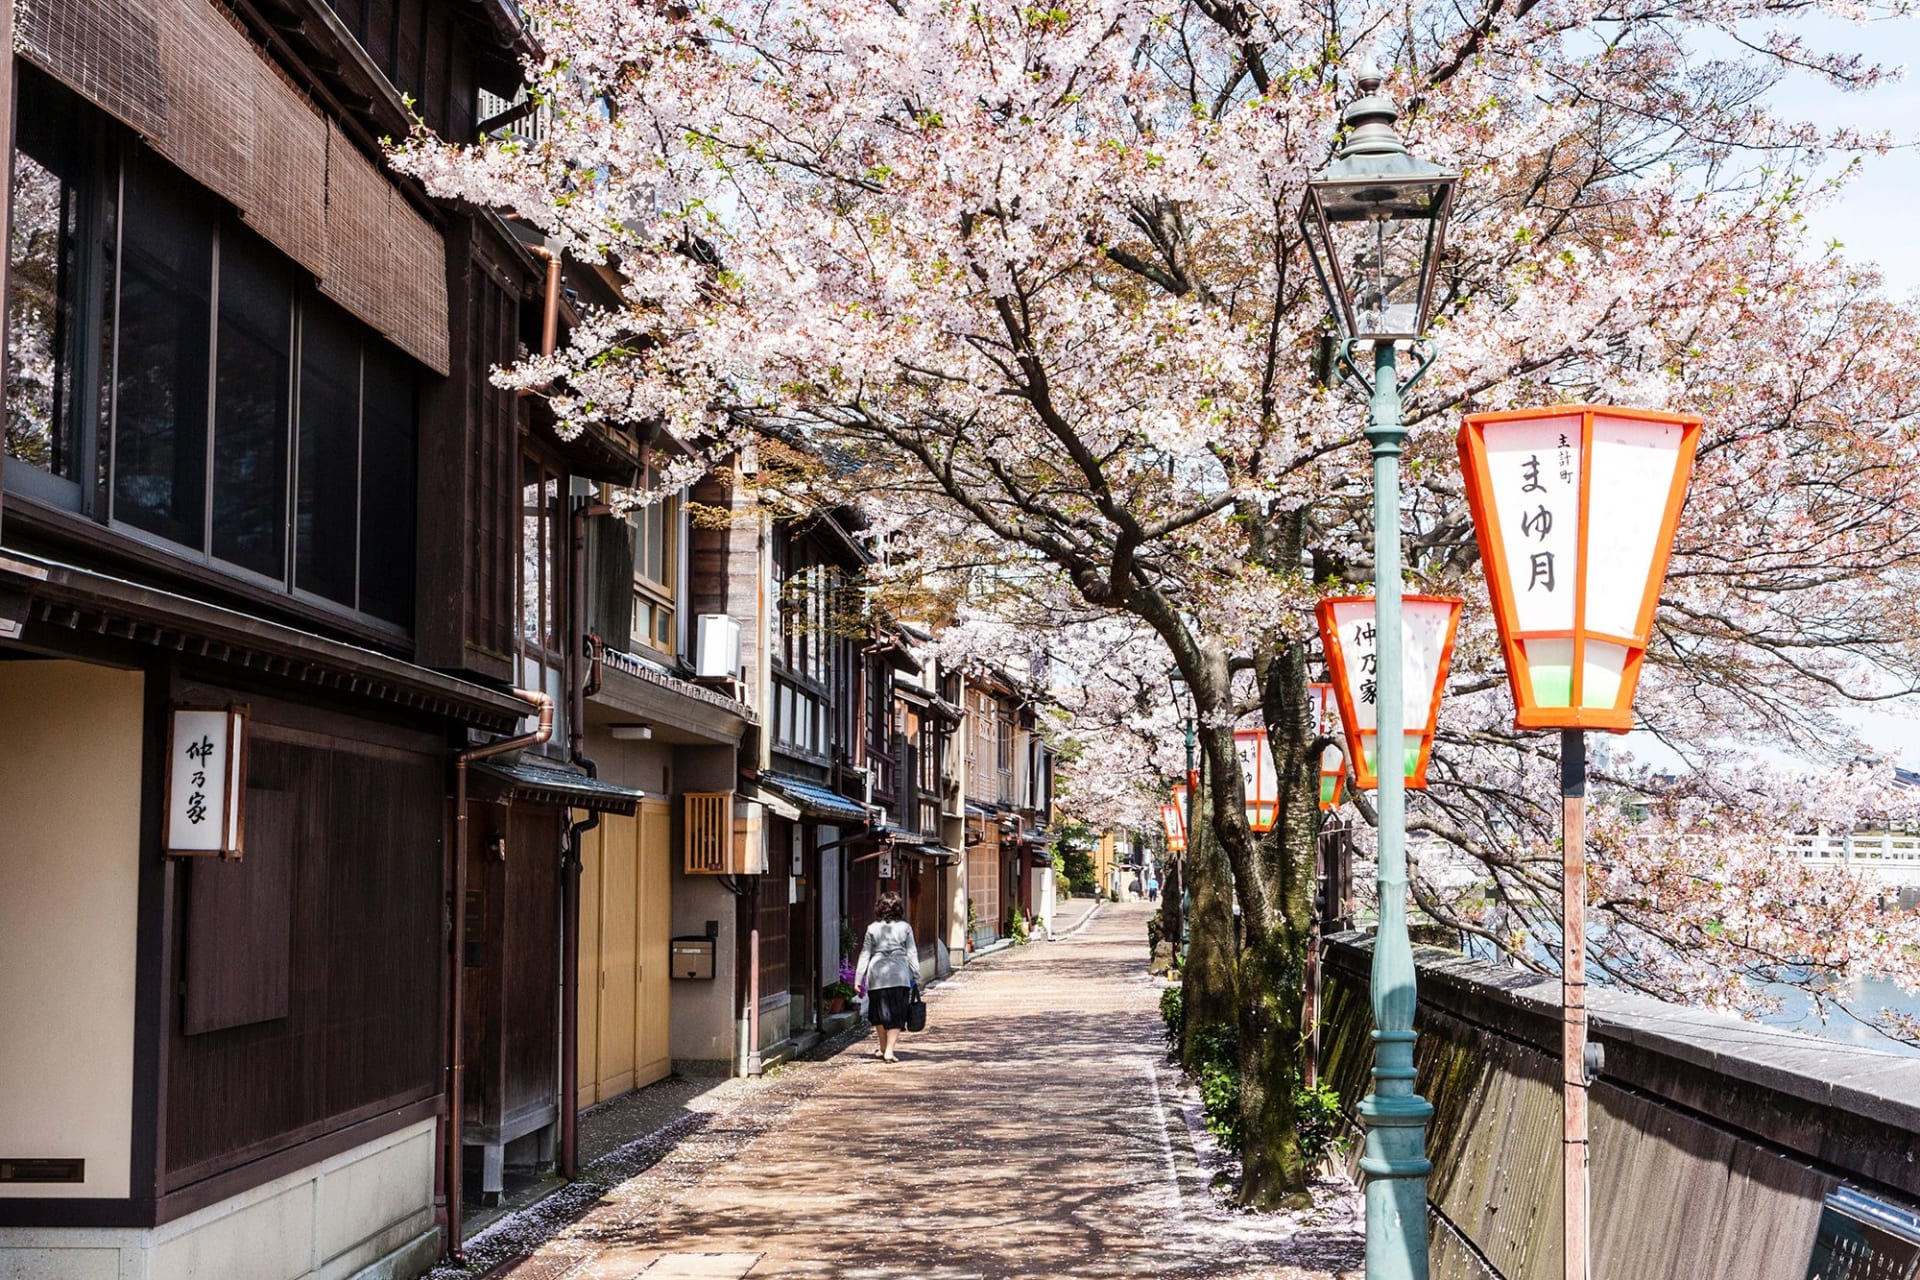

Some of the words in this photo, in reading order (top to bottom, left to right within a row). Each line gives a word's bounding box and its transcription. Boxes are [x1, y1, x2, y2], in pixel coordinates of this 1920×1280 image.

[1557, 433, 1573, 484] 主計町
[1521, 454, 1556, 592] まゆ月
[185, 735, 214, 824] 仲乃家
